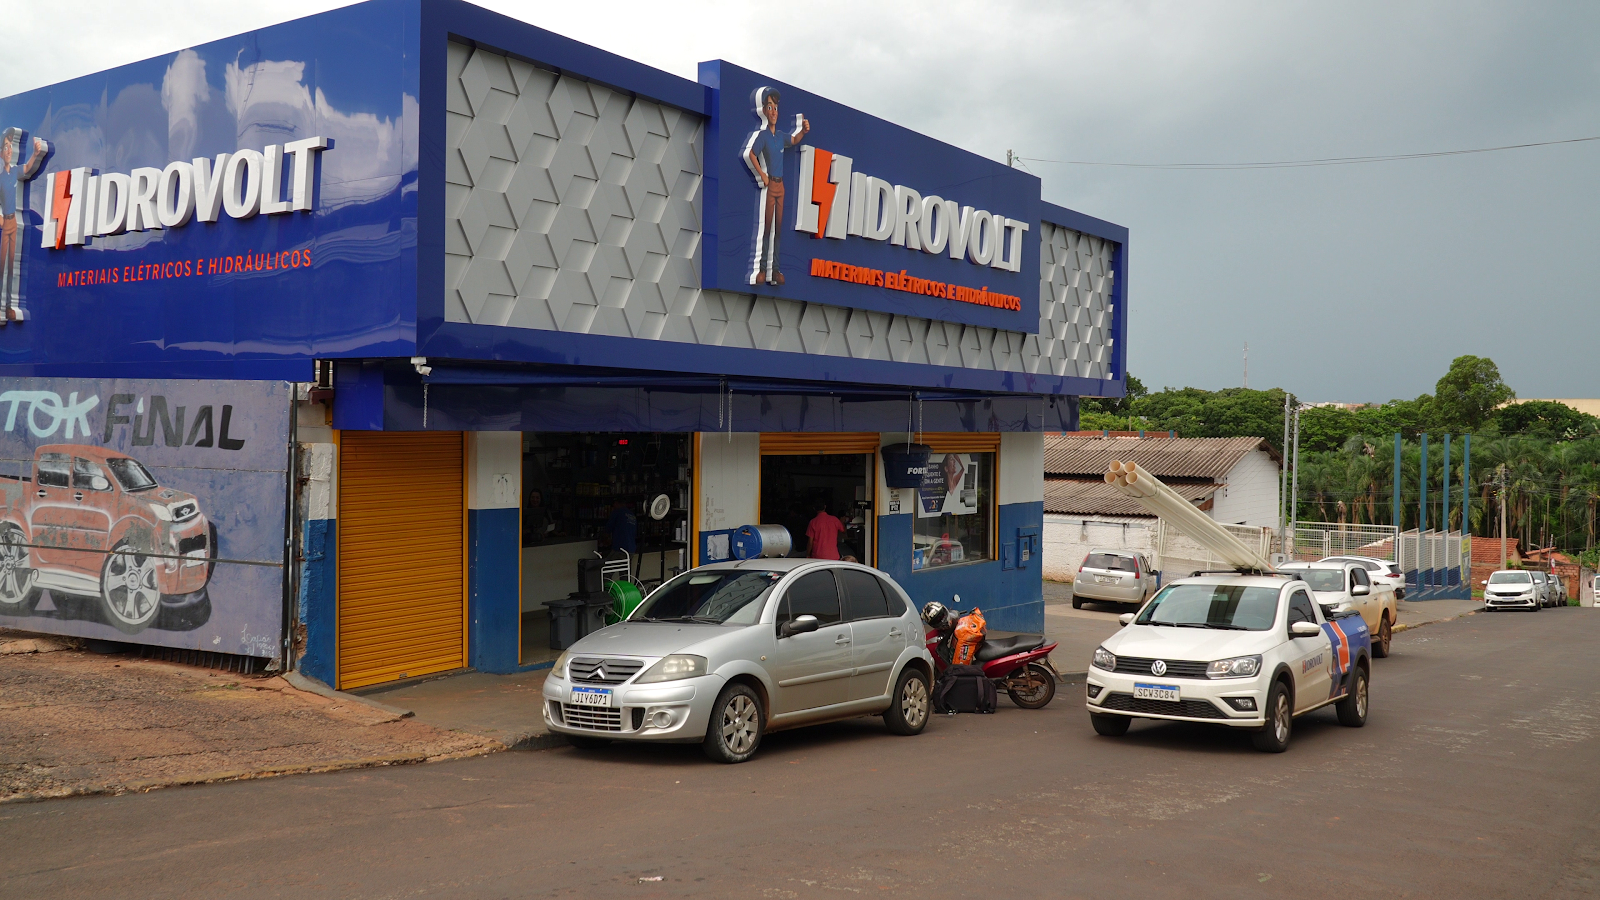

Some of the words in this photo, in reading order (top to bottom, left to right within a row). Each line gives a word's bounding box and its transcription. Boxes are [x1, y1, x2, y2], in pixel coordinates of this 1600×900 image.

[41, 136, 328, 250] HIDROVOLT
[795, 144, 1030, 273] HIDROVOLT
[57, 268, 119, 287] MATERIAIS
[123, 260, 192, 283] ELÉTRICOS
[196, 259, 204, 276] E
[208, 249, 312, 275] HIDRÁULICOS
[810, 258, 884, 287] MATERIAIS
[885, 270, 947, 299] ELÉTRICOS
[947, 284, 956, 300] E
[956, 286, 1022, 312] HIDRÁULICOS
[0, 390, 100, 439] TOK
[575, 693, 607, 705] JIY6D71
[1138, 688, 1175, 699] SCW3C84
